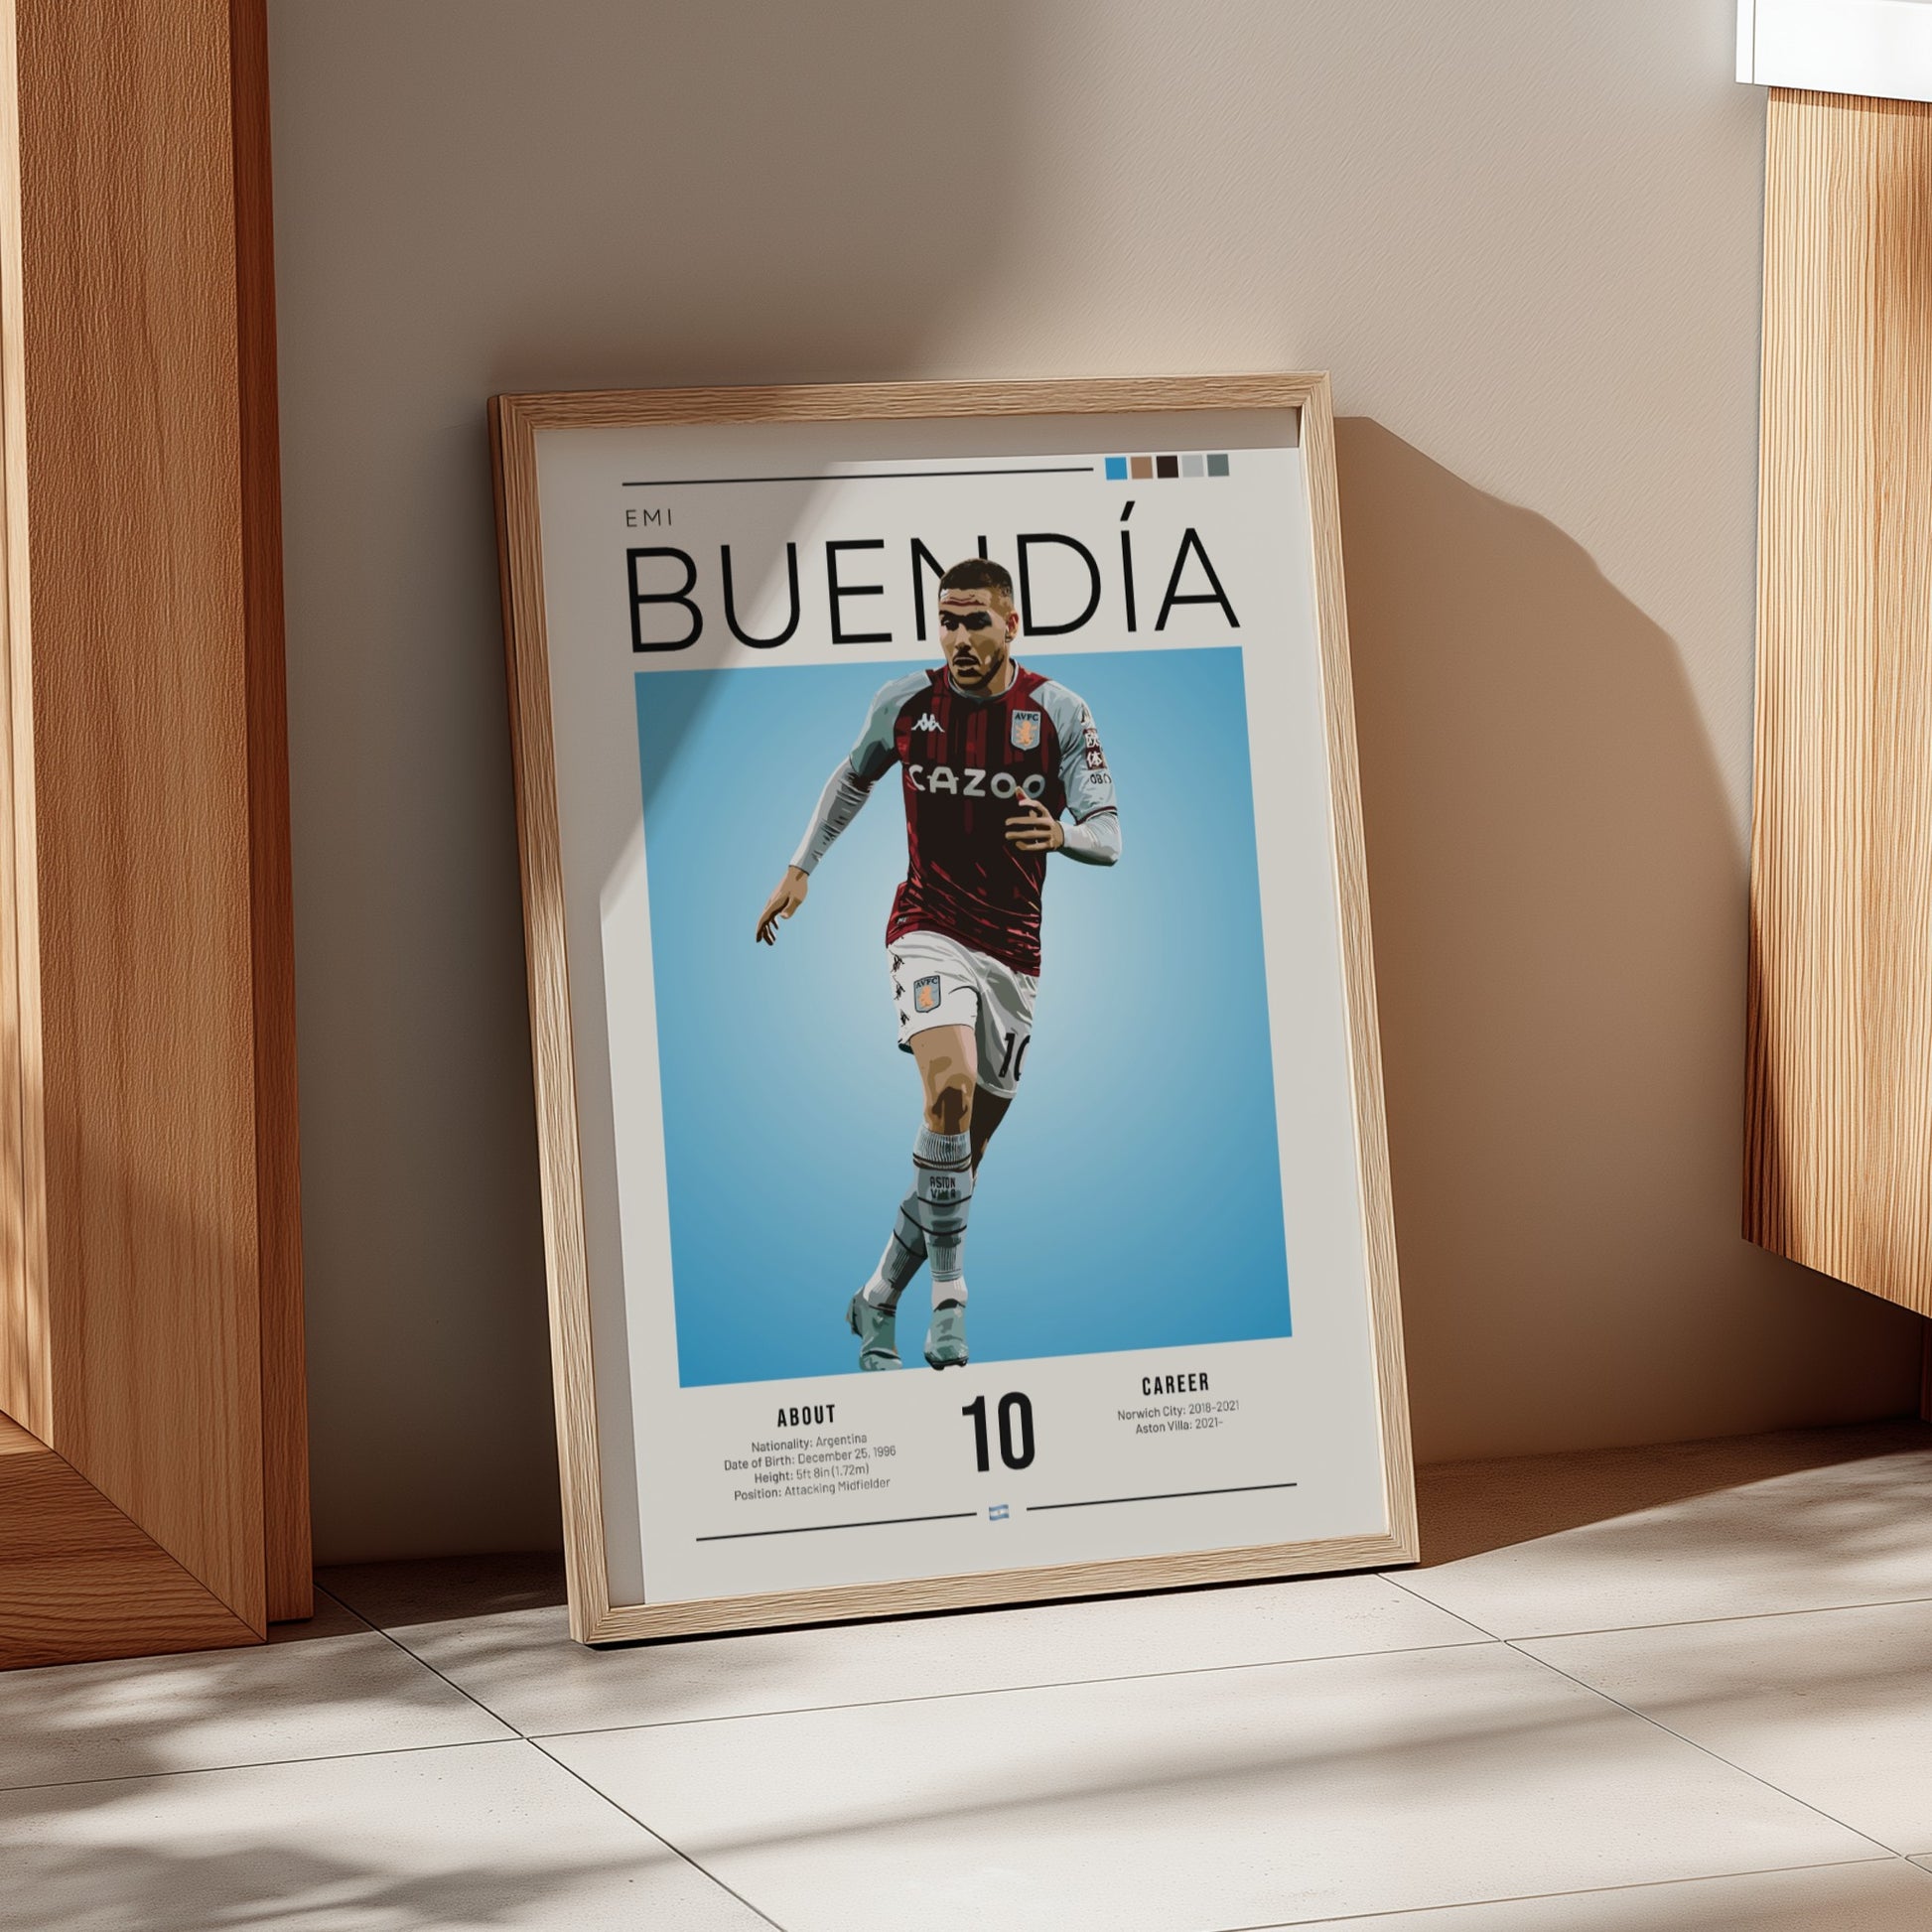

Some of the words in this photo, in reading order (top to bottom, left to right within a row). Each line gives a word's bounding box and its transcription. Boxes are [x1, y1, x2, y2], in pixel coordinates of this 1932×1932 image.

[625, 507, 673, 528] EMI
[625, 500, 1241, 654] BUENDÍA
[908, 763, 1046, 800] CAZOO
[929, 1176, 956, 1189] ASTON
[1142, 1372, 1209, 1396] CAREER
[777, 1404, 836, 1428] ABOUT
[1117, 1407, 1161, 1421] Norwich
[1163, 1404, 1186, 1420] City:
[1188, 1399, 1240, 1415] 2018-2021
[962, 1391, 1035, 1472] 10
[1136, 1421, 1166, 1435] Aston
[1168, 1418, 1192, 1431] Villa:
[1194, 1416, 1224, 1430] 2021-
[752, 1440, 814, 1453] Nationality:
[815, 1434, 868, 1449] Argentina
[724, 1457, 749, 1471] Date
[752, 1456, 762, 1468] of
[764, 1453, 795, 1467] Birth:
[797, 1449, 853, 1464] December
[873, 1445, 897, 1457] 1996
[755, 1470, 794, 1484] Height:
[796, 1468, 811, 1480] 5ft
[734, 1488, 782, 1501] Position:
[784, 1483, 836, 1497] Attacking
[837, 1477, 892, 1492] Midfielder
